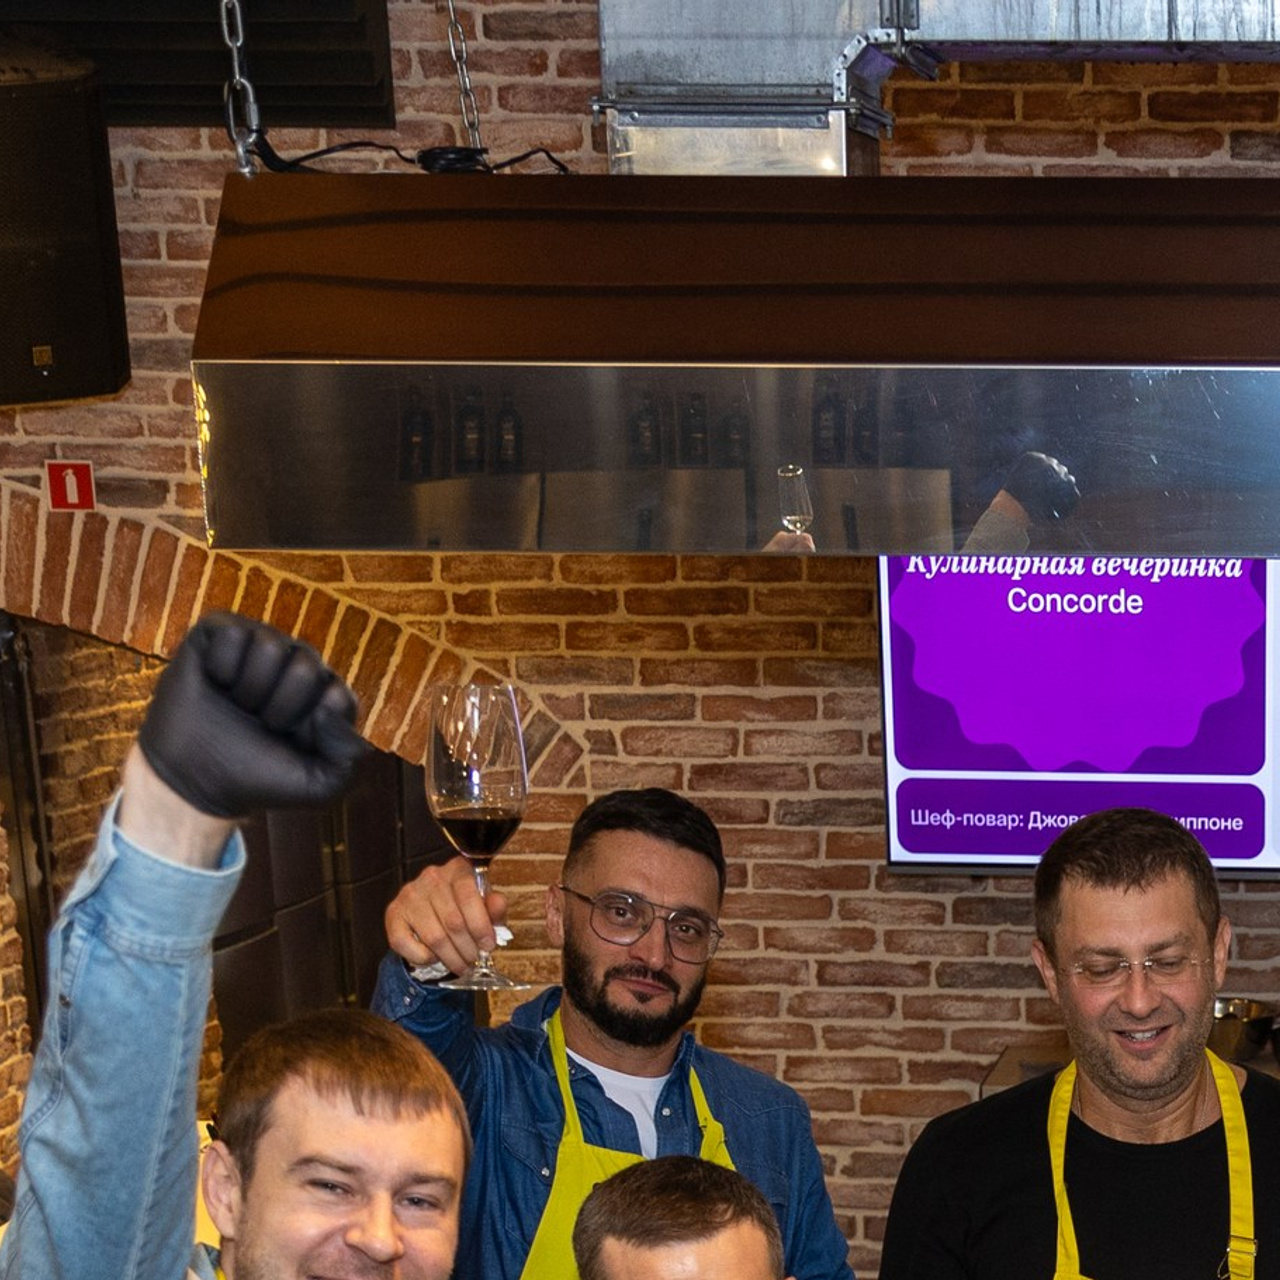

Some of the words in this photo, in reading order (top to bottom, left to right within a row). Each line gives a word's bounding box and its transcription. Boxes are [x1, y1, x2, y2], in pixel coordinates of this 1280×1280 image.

[906, 556, 1086, 581] Кулинарная
[1091, 556, 1244, 583] вечеринка
[1007, 587, 1144, 614] Concorde
[910, 808, 1025, 831] Шеф-повар:
[1028, 810, 1086, 831] Джов
